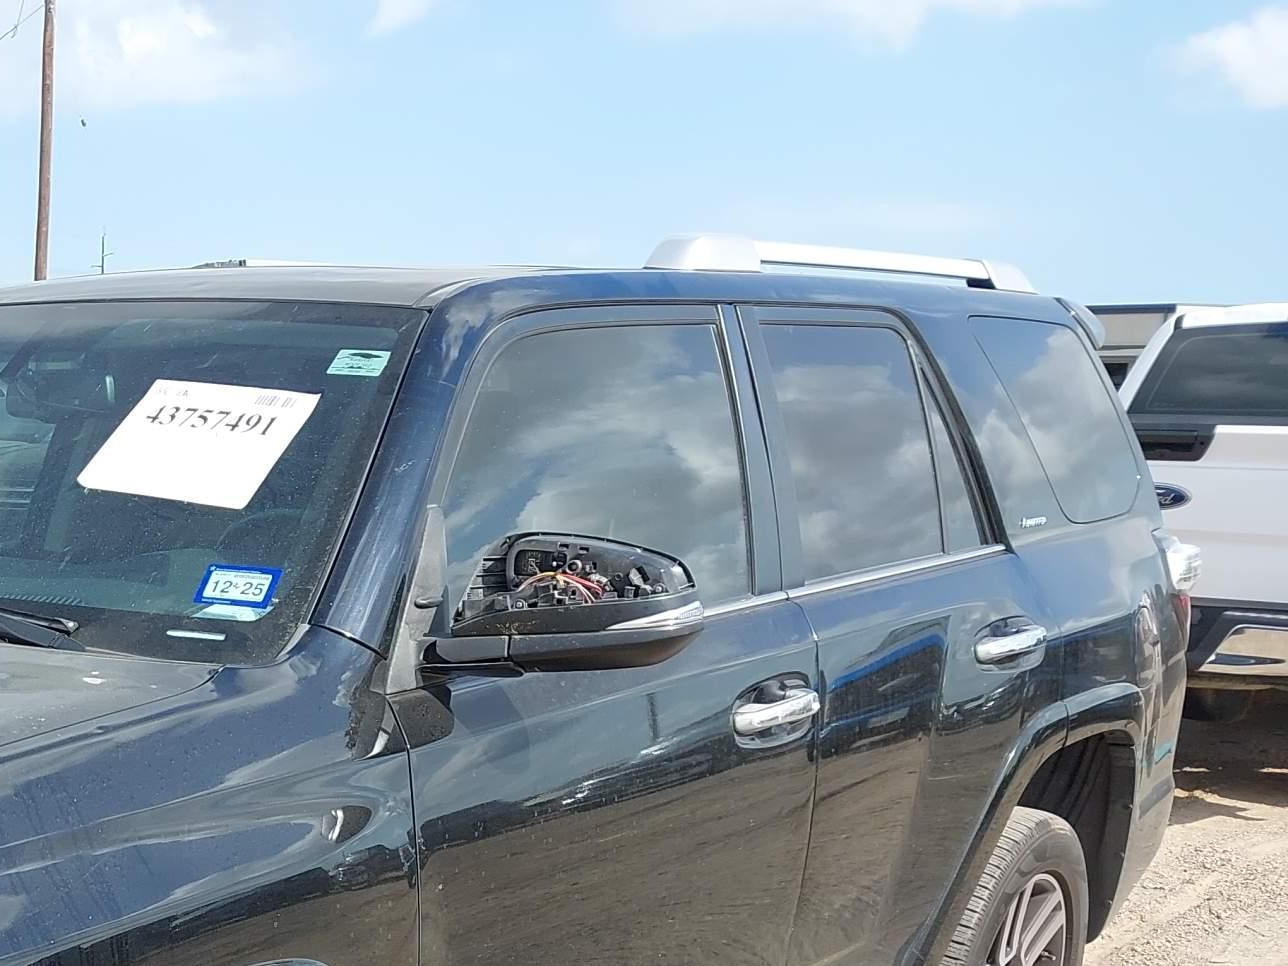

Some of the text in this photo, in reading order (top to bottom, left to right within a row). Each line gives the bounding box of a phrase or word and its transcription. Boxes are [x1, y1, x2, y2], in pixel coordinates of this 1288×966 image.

[146, 405, 278, 436] 43757491
[212, 580, 266, 597] 12 25
